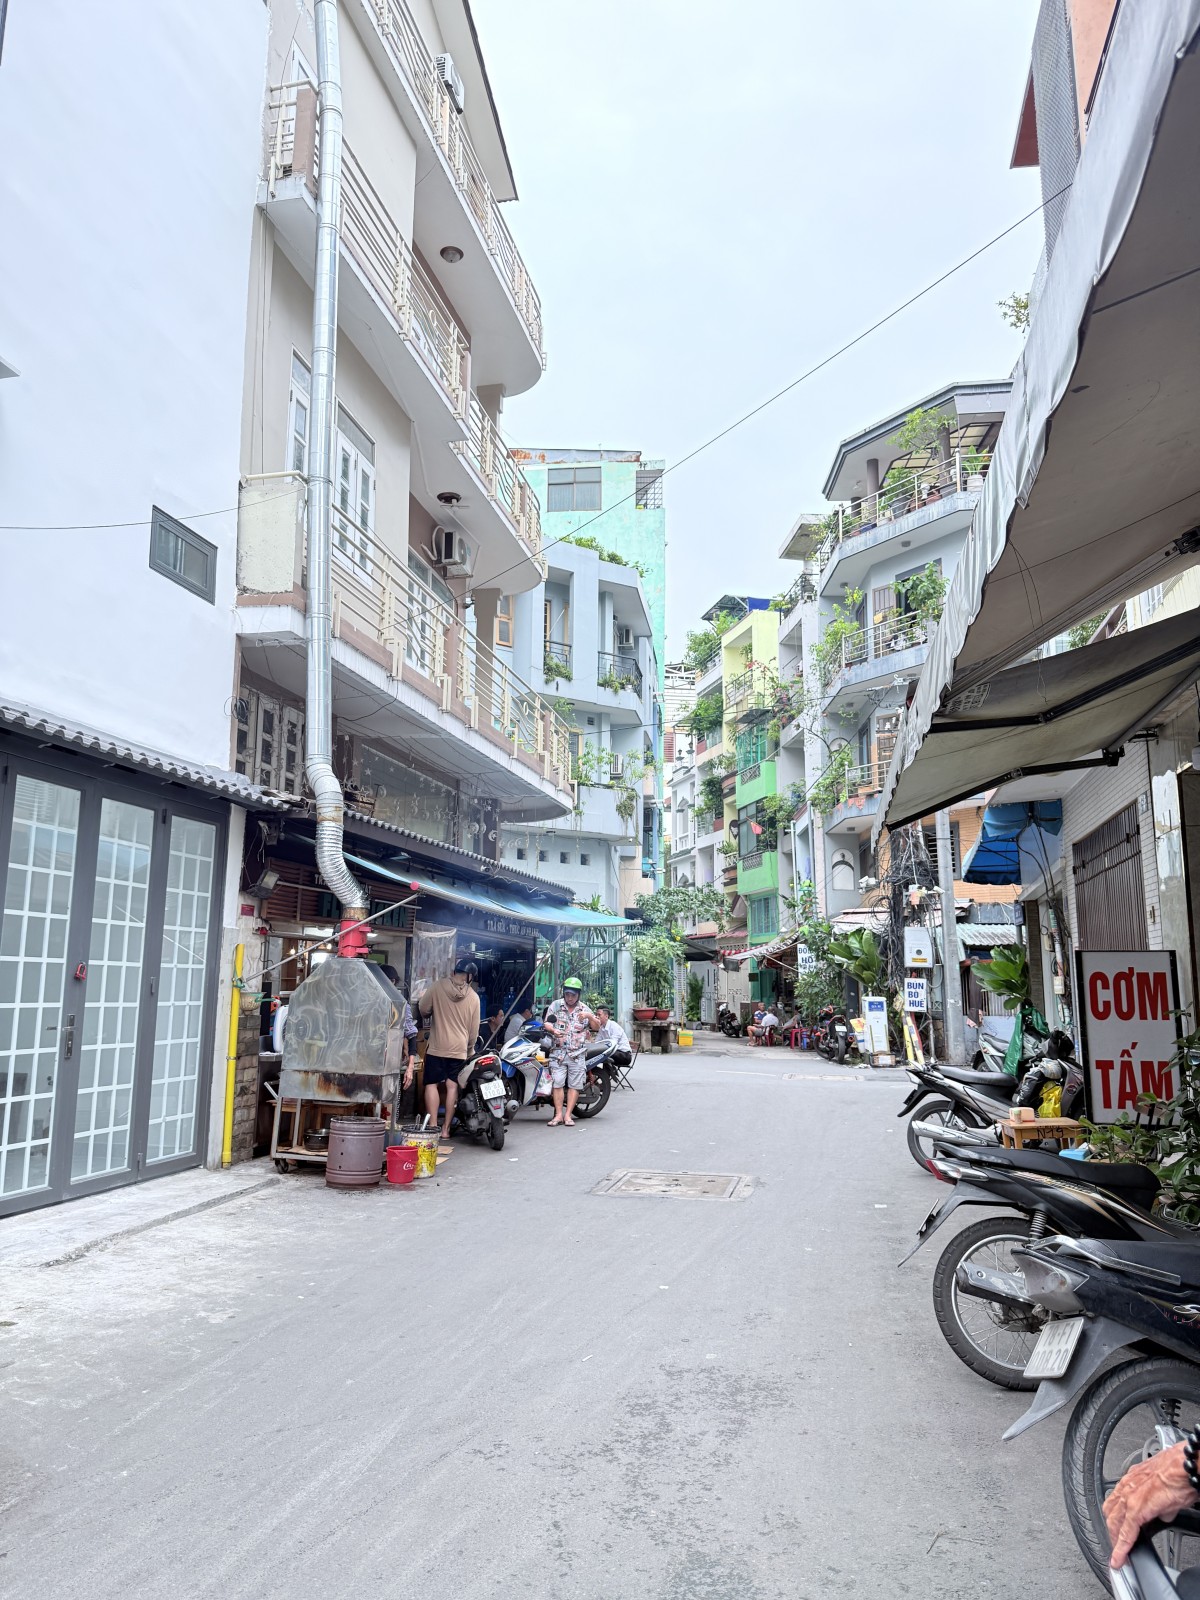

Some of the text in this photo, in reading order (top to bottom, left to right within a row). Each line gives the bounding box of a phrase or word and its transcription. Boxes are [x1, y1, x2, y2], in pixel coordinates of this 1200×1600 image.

[907, 981, 924, 990] BÚN
[908, 990, 919, 999] BÒ
[1089, 967, 1170, 1021] CƠM
[909, 998, 925, 1008] HUẾ
[1095, 1042, 1174, 1109] TẤM
